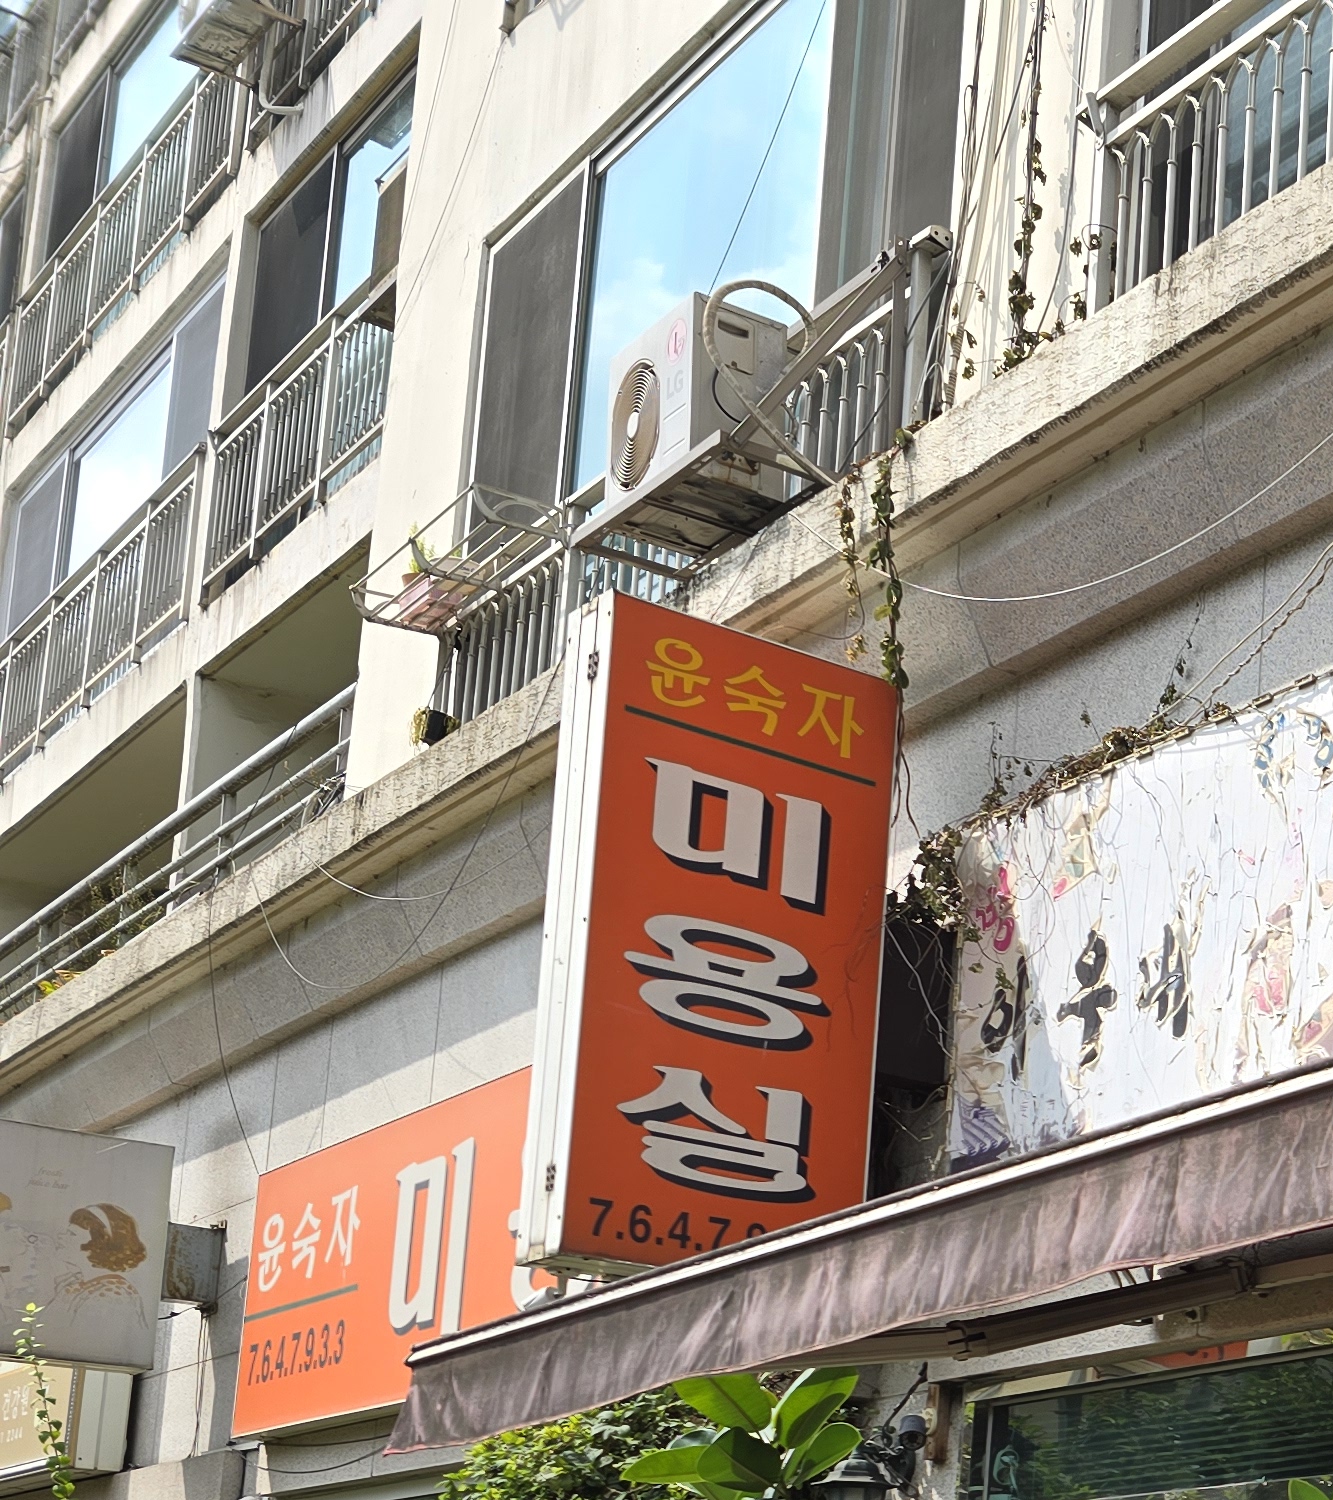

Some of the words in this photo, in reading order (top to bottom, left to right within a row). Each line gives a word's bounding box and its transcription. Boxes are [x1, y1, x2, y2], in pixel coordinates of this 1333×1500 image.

[645, 637, 865, 759] 윤숙자
[616, 756, 834, 1202] 미용실
[257, 1184, 361, 1293] 윤숙자
[246, 1318, 347, 1387] 7.6.4.7.9.3.3
